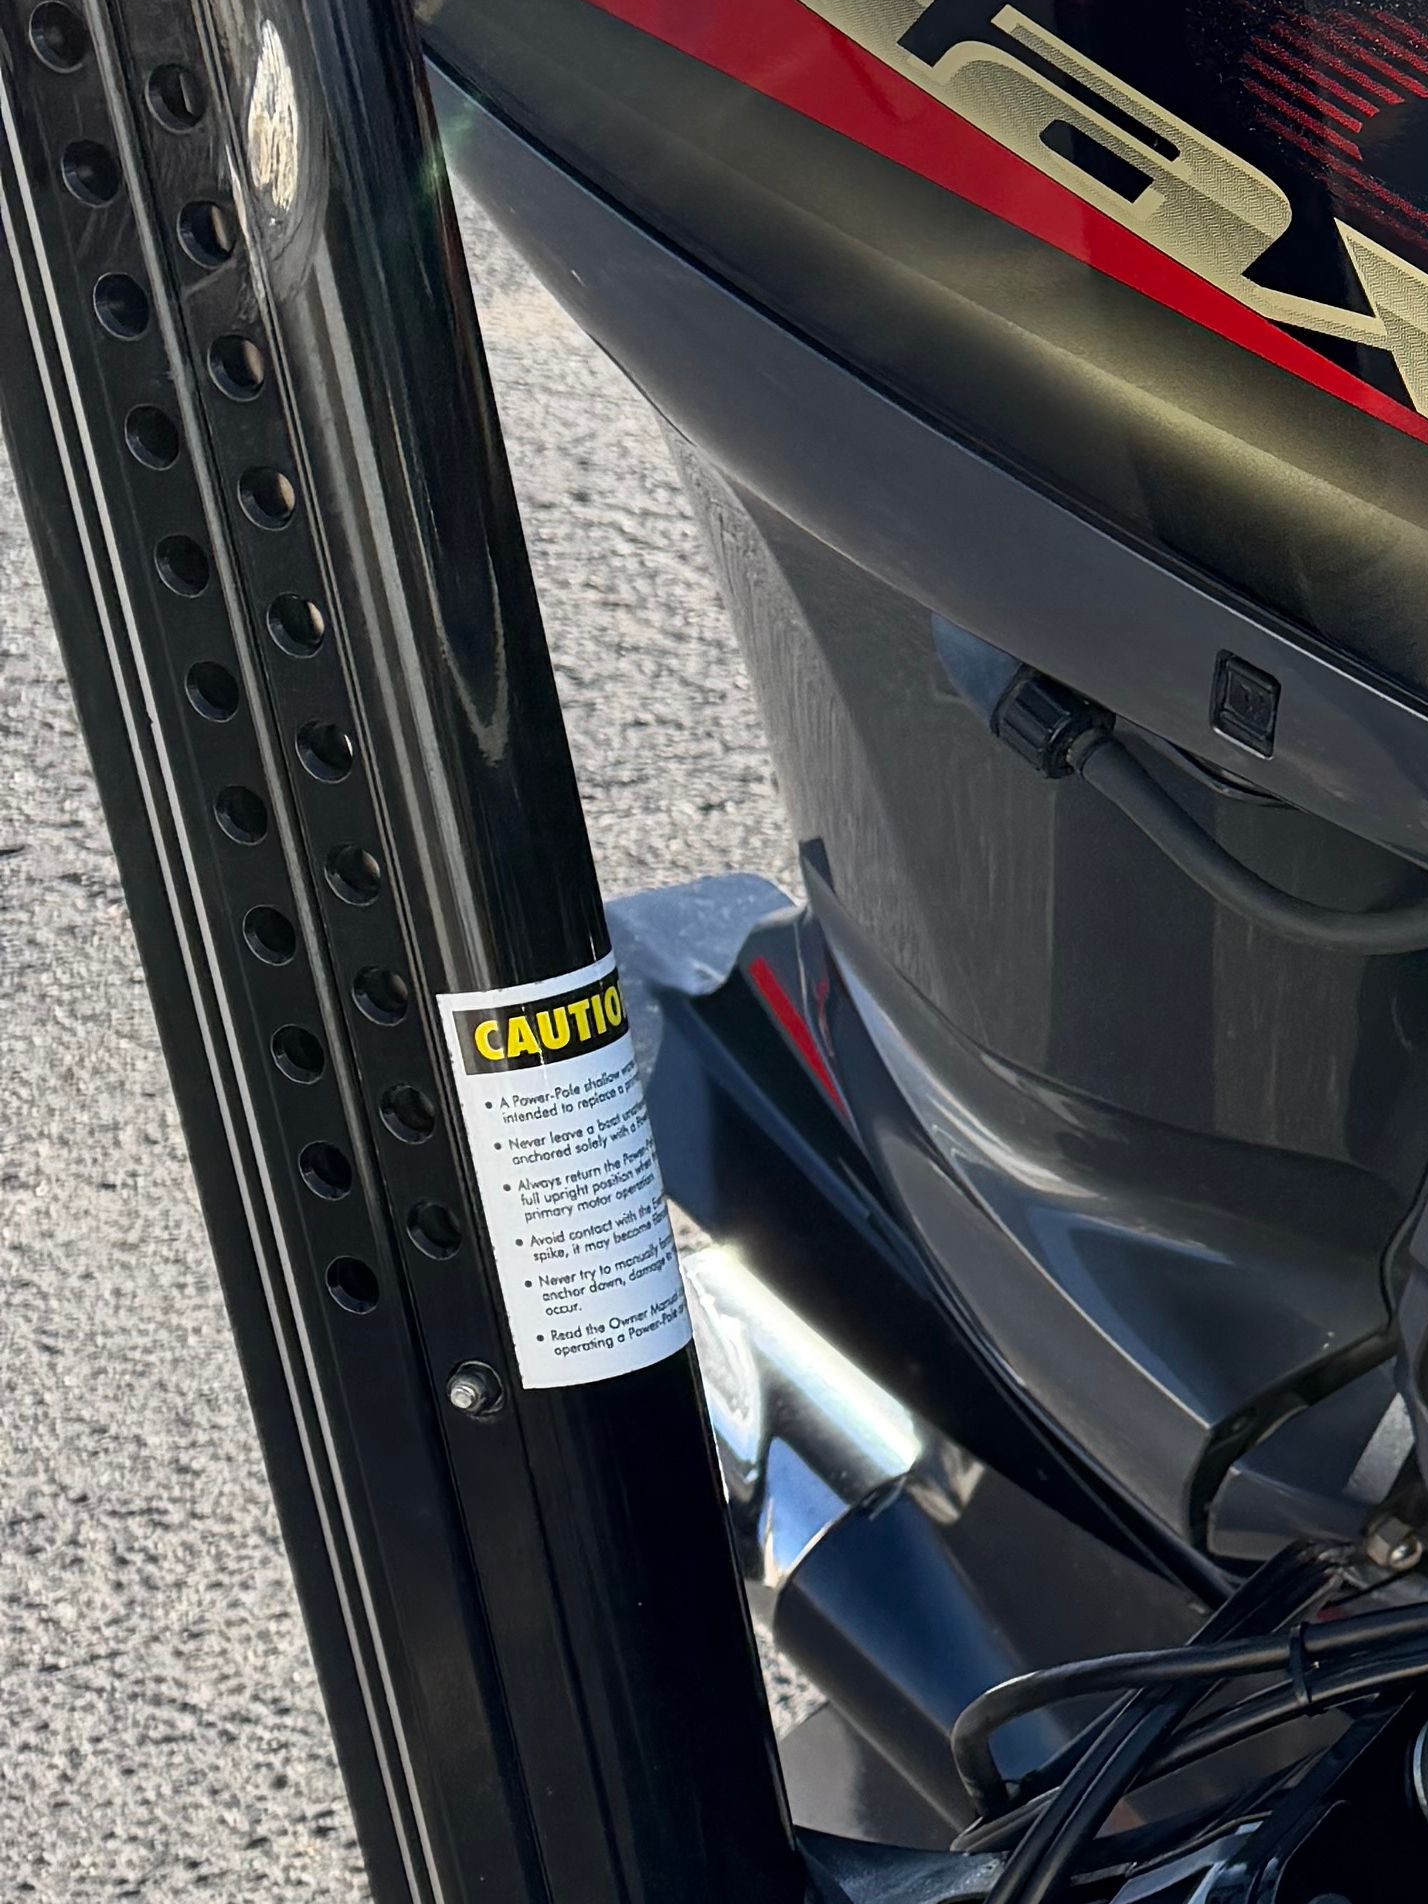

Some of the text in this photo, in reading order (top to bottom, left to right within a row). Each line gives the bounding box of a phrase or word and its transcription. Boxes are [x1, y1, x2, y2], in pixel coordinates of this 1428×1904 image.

[474, 985, 624, 1061] CAUTIO
[500, 1096, 510, 1109] A
[512, 1083, 580, 1108] Power-Pole
[584, 1072, 620, 1093] shallow
[502, 1103, 558, 1125] intended
[562, 1103, 573, 1114] to
[578, 1089, 617, 1110] replace
[617, 1085, 624, 1095] a
[509, 1136, 546, 1151] Never
[550, 1130, 583, 1144] leave
[586, 1125, 595, 1135] a
[512, 1144, 572, 1166] anchored
[575, 1134, 608, 1154] solely
[610, 1124, 630, 1142] with
[518, 1177, 562, 1192] Always
[566, 1167, 601, 1184] return
[604, 1159, 621, 1174] the
[521, 1191, 541, 1206] full
[544, 1184, 589, 1205] upright
[592, 1170, 634, 1196] position
[524, 1205, 573, 1225] primary
[577, 1194, 612, 1211] motor
[530, 1230, 566, 1248] Avoid
[569, 1220, 613, 1241] contact
[615, 1210, 638, 1228] with
[533, 1246, 569, 1264] spike,
[572, 1243, 581, 1255] it
[585, 1238, 610, 1253] may
[613, 1221, 652, 1244] become
[538, 1273, 577, 1288] Never
[580, 1269, 597, 1281] try
[599, 1265, 612, 1276] to
[615, 1243, 658, 1272] manually
[542, 1286, 586, 1302] anchor
[589, 1277, 626, 1294] down,
[545, 1303, 582, 1316] occur.
[550, 1325, 583, 1342] Read
[585, 1322, 606, 1336] the
[608, 1310, 648, 1330] Owner
[554, 1337, 614, 1358] operating
[617, 1333, 625, 1343] a
